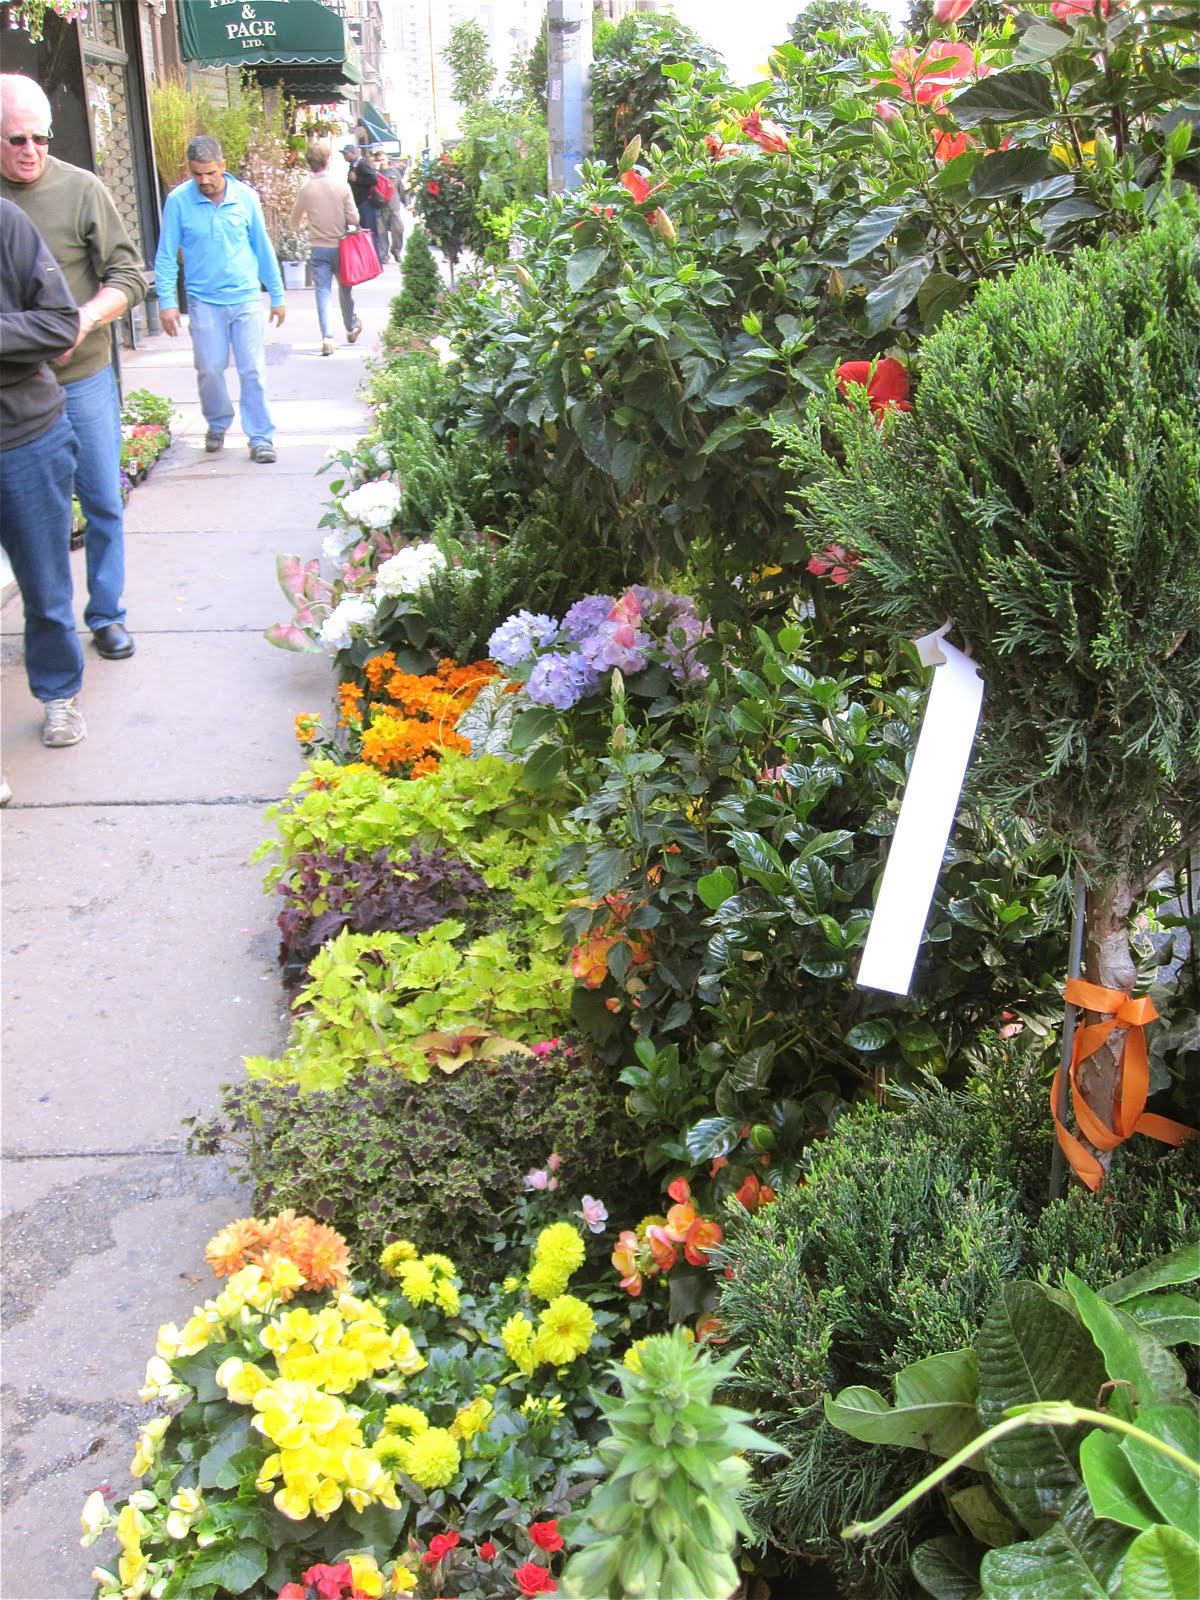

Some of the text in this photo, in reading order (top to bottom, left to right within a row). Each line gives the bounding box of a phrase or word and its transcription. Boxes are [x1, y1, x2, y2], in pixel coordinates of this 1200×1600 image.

[241, 4, 256, 20] &
[225, 21, 276, 39] PAGE
[242, 39, 265, 48] LTD.
